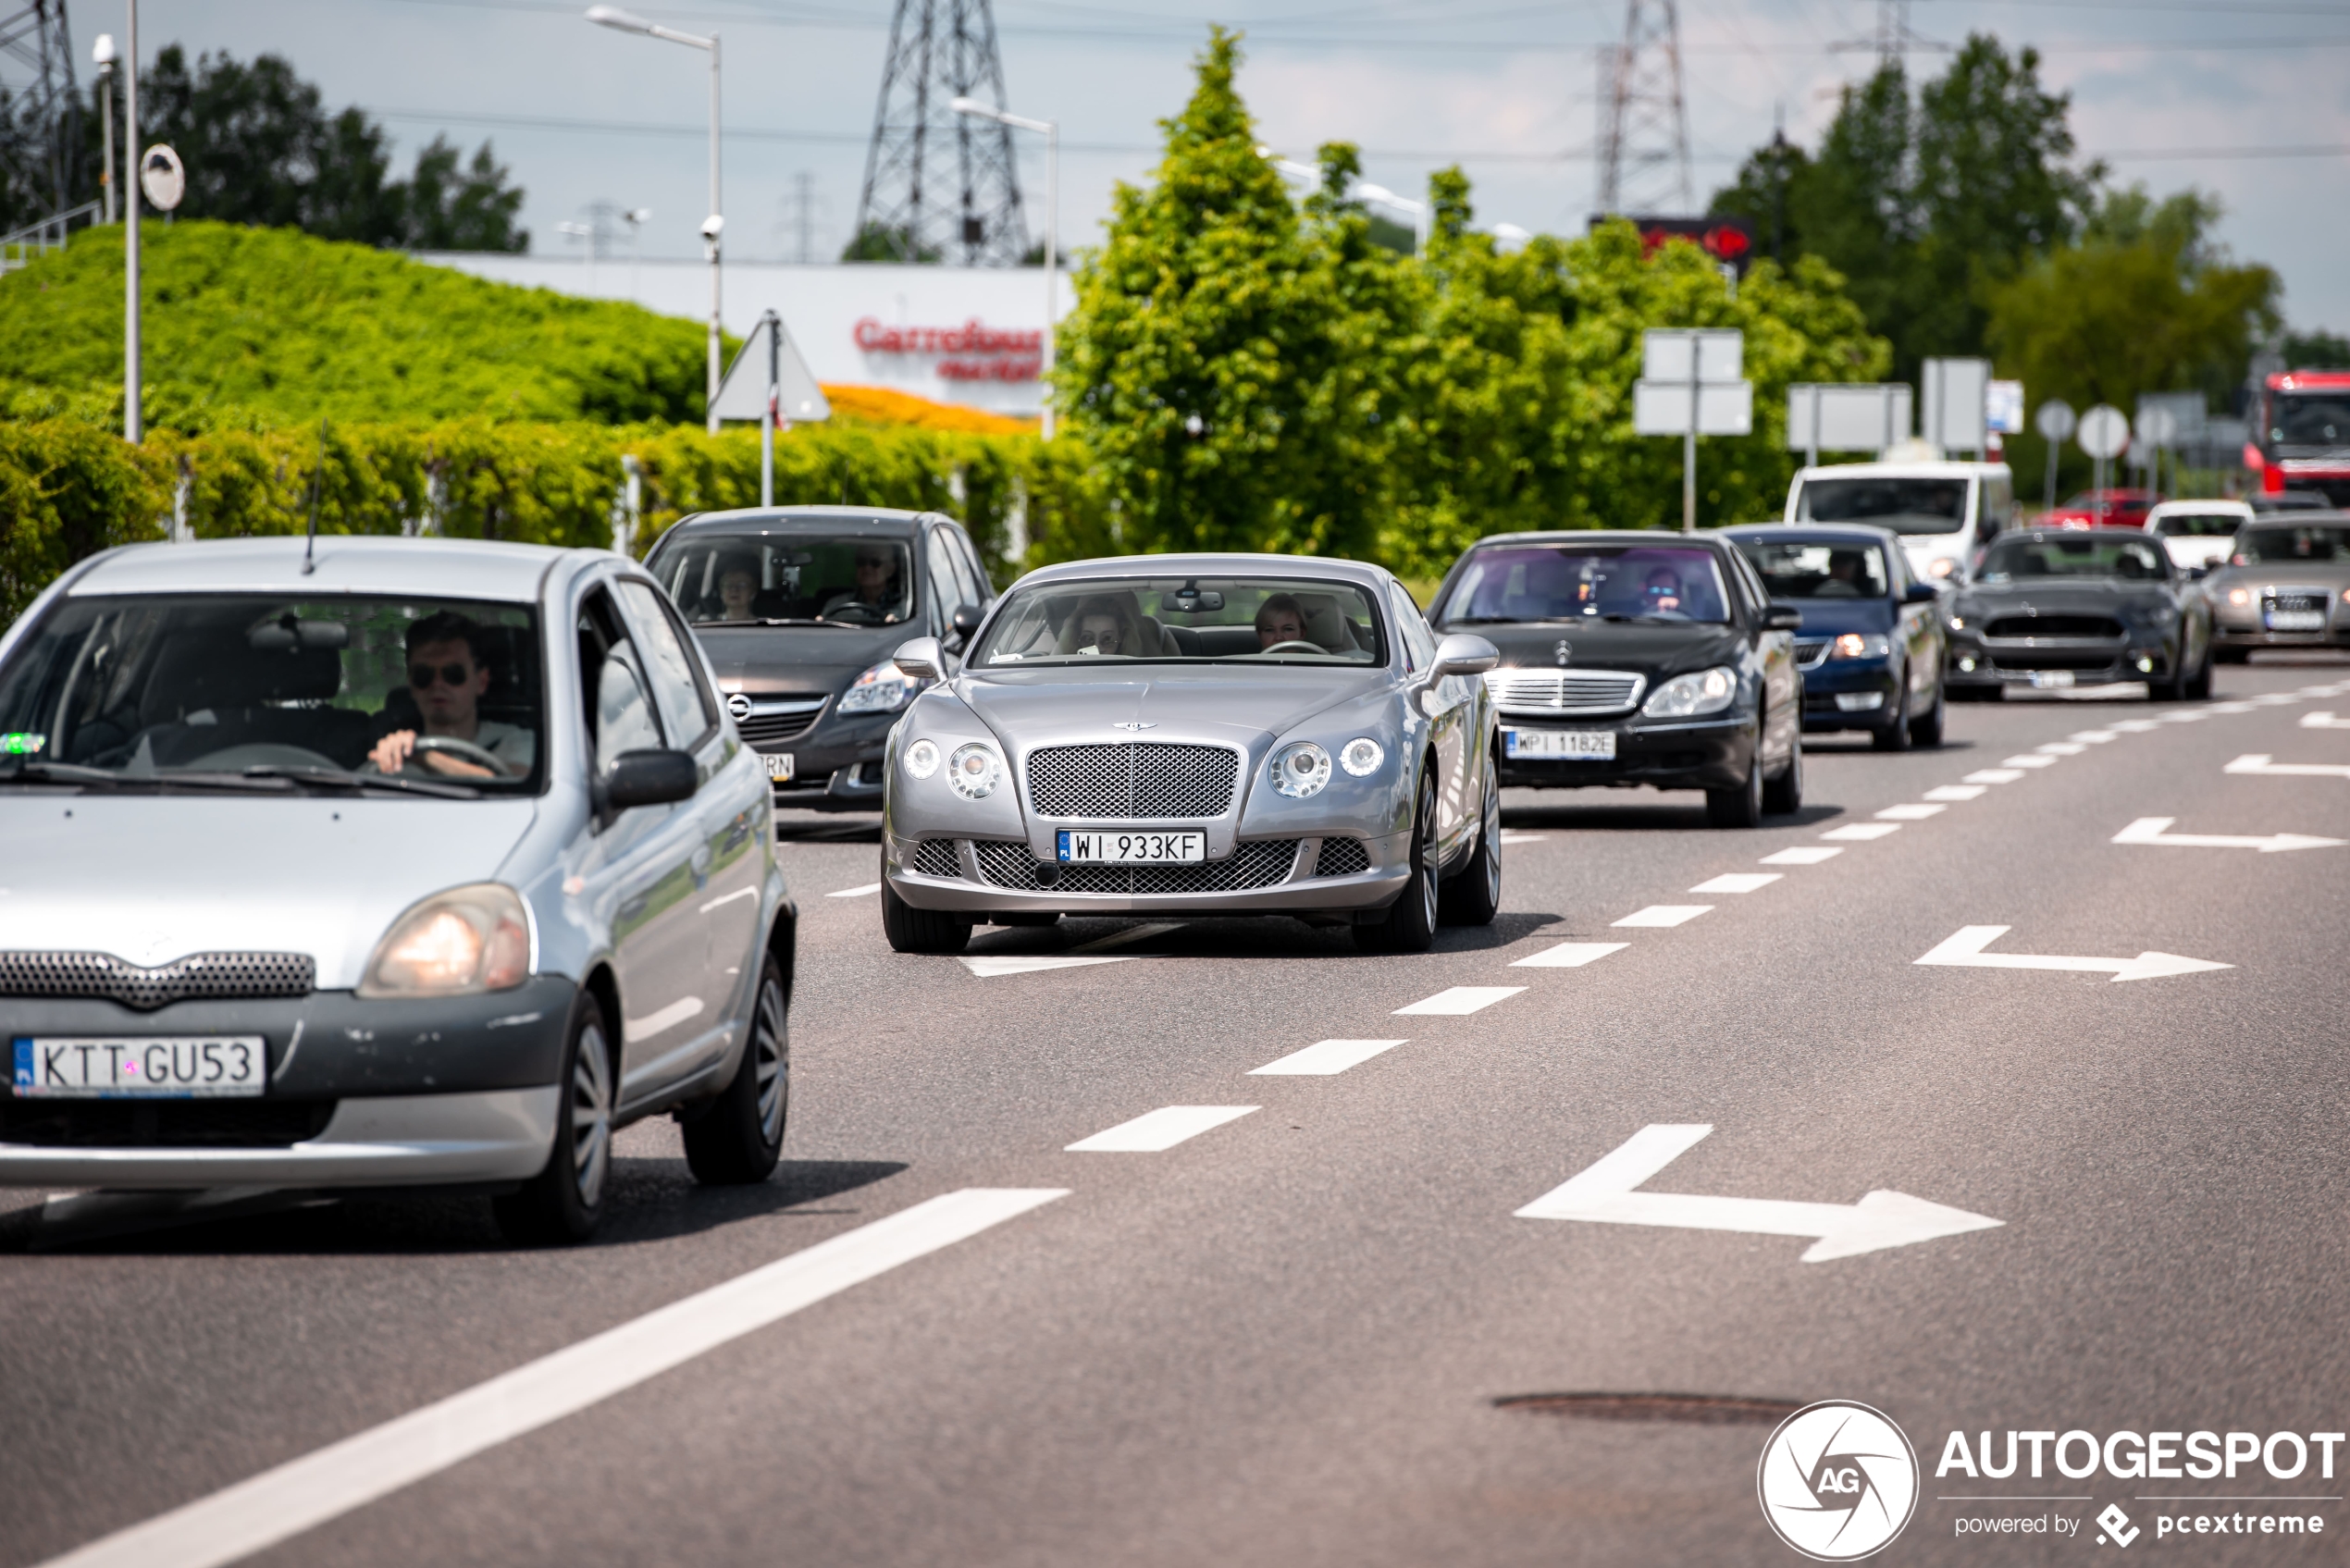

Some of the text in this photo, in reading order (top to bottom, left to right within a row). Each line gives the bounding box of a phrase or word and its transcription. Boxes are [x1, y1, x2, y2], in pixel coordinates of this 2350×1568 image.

[852, 317, 1042, 352] Carrefour
[1519, 735, 1549, 751] WPI
[1076, 834, 1197, 859] WI 933KF
[44, 1043, 252, 1085] KTT GU53
